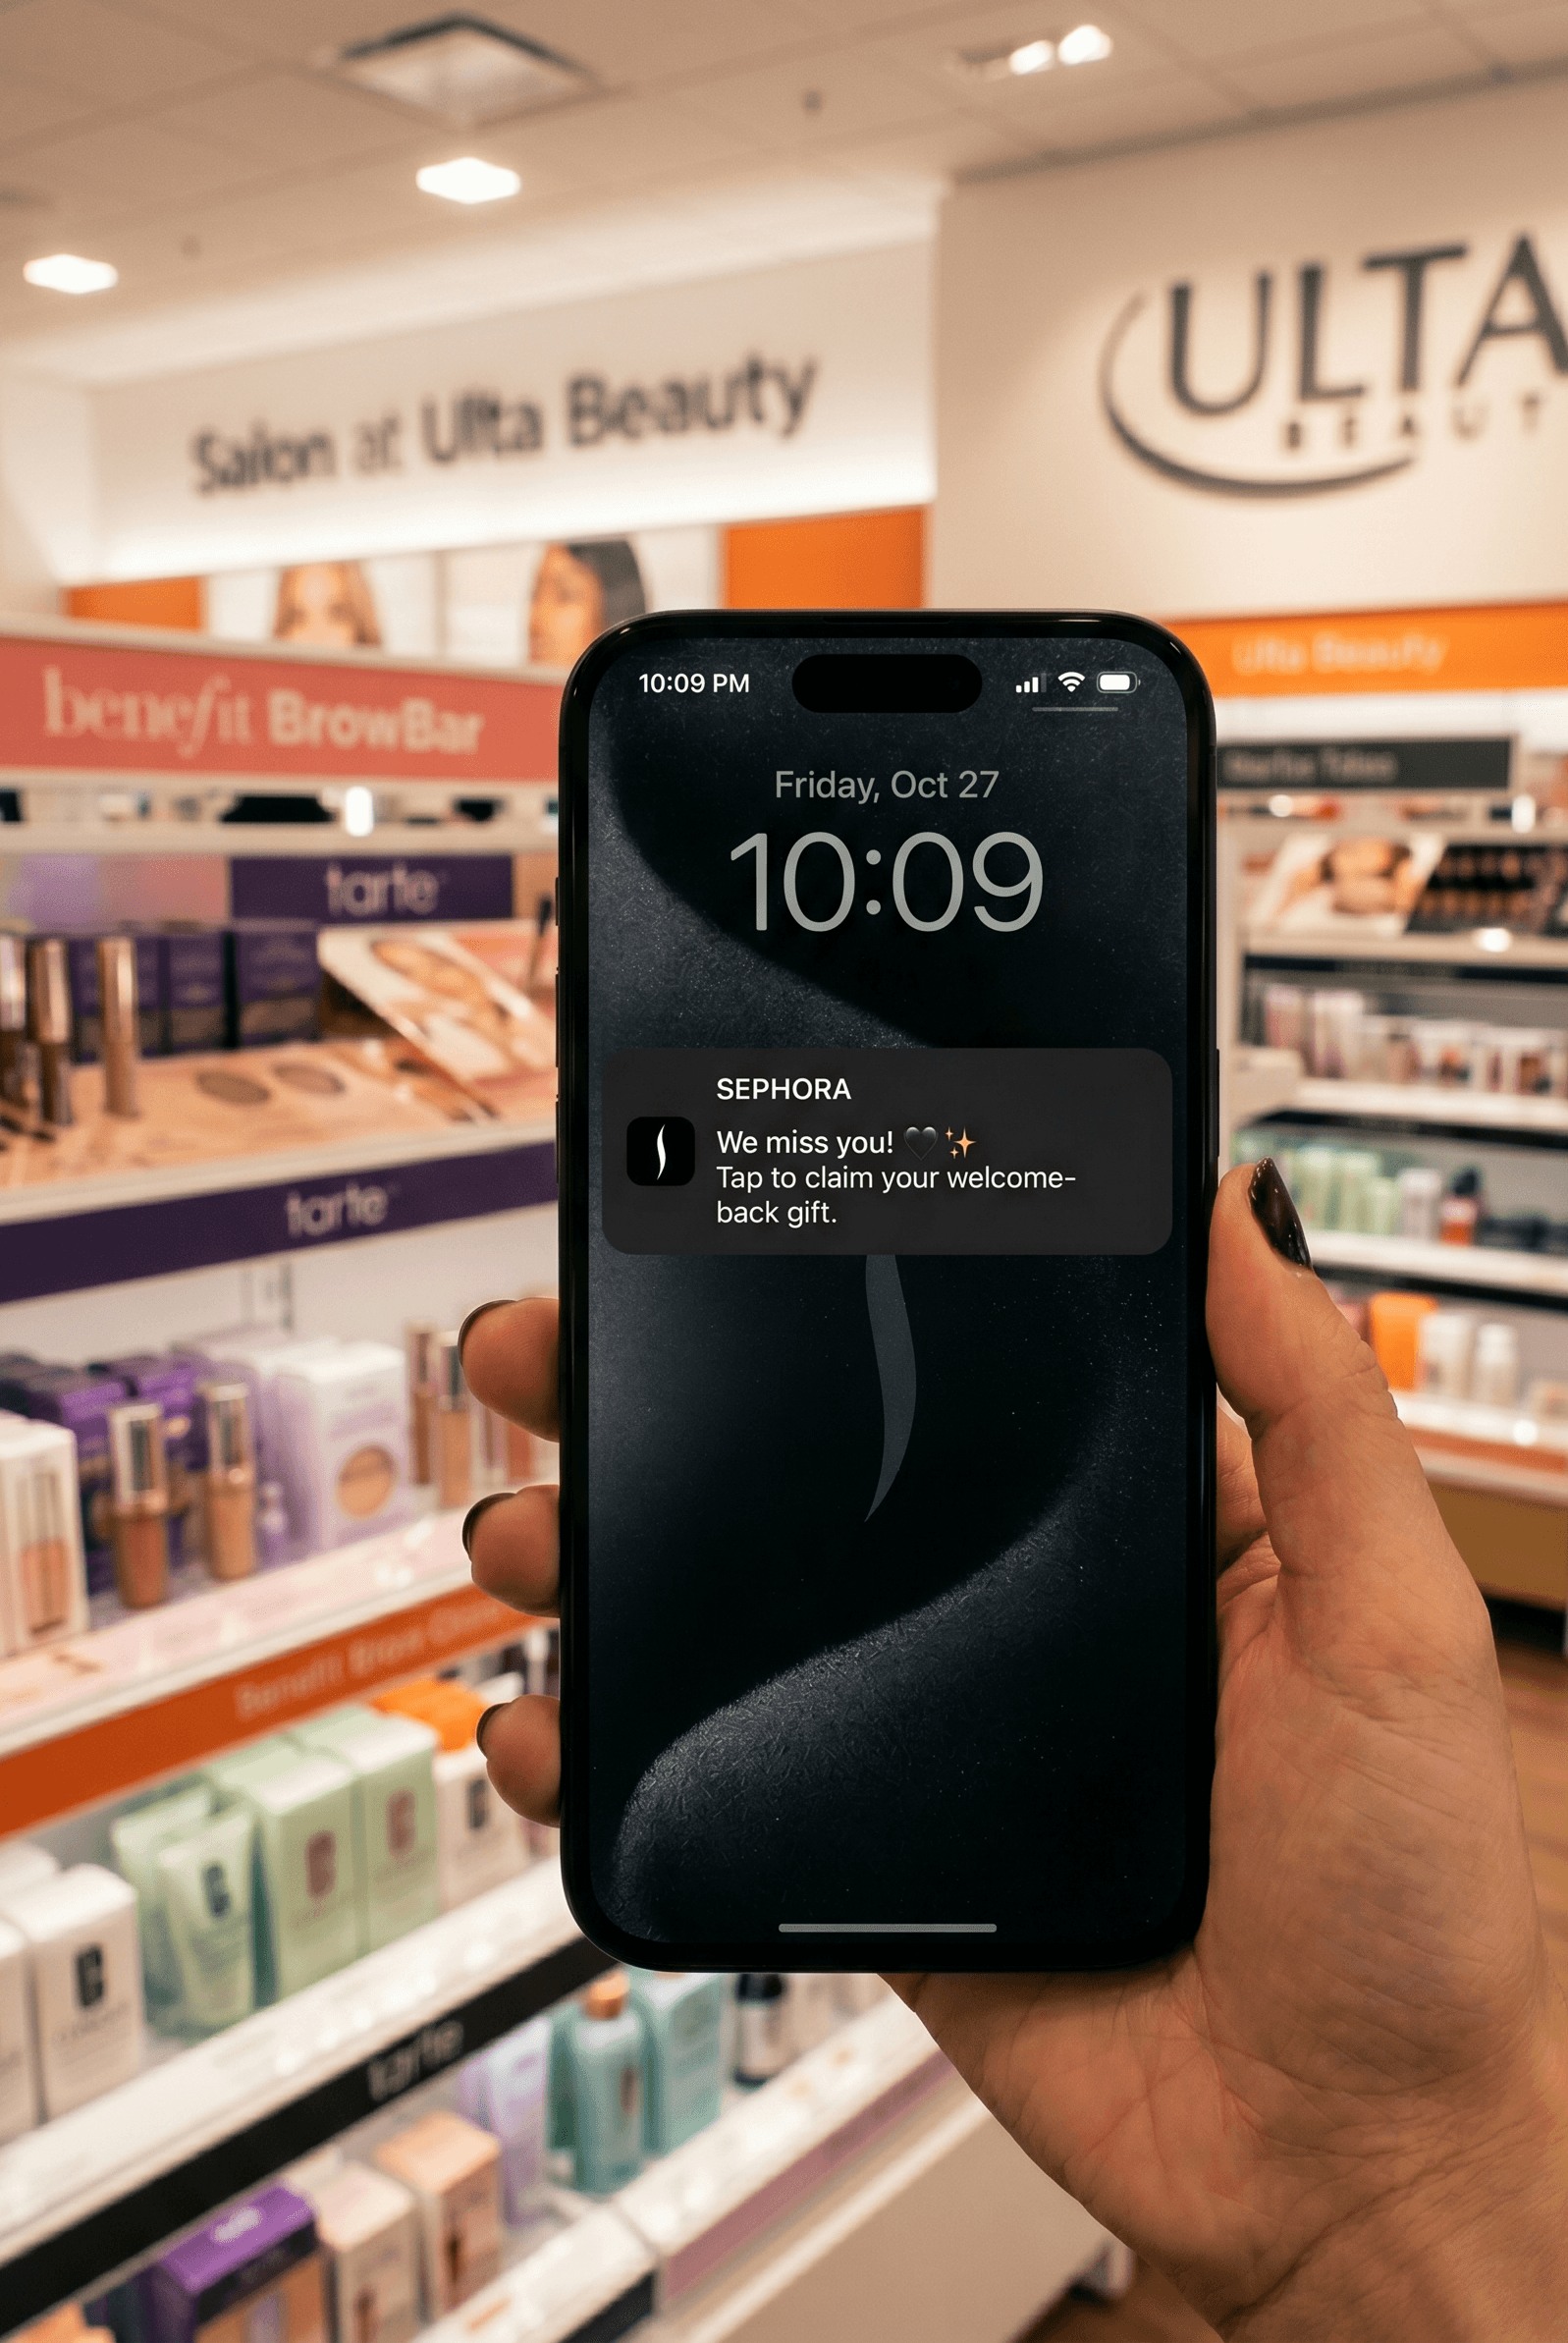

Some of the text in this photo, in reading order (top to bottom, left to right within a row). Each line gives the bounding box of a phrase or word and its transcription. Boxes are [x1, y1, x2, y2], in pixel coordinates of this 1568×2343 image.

[1168, 234, 1568, 416] ULTA
[191, 350, 815, 497] Salon at Ulta Beauty
[638, 673, 749, 693] 10:09 PM
[42, 666, 252, 758] benefit
[776, 770, 1000, 805] Friday, Oct 27
[326, 862, 439, 916] tarte
[730, 831, 1044, 932] 10:09
[716, 1077, 852, 1101] SEPHORA
[716, 1128, 893, 1160] We miss you!
[716, 1165, 1076, 1194] Tap to claim your welcome-
[286, 1181, 389, 1237] tarte
[716, 1200, 837, 1229] back gift.
